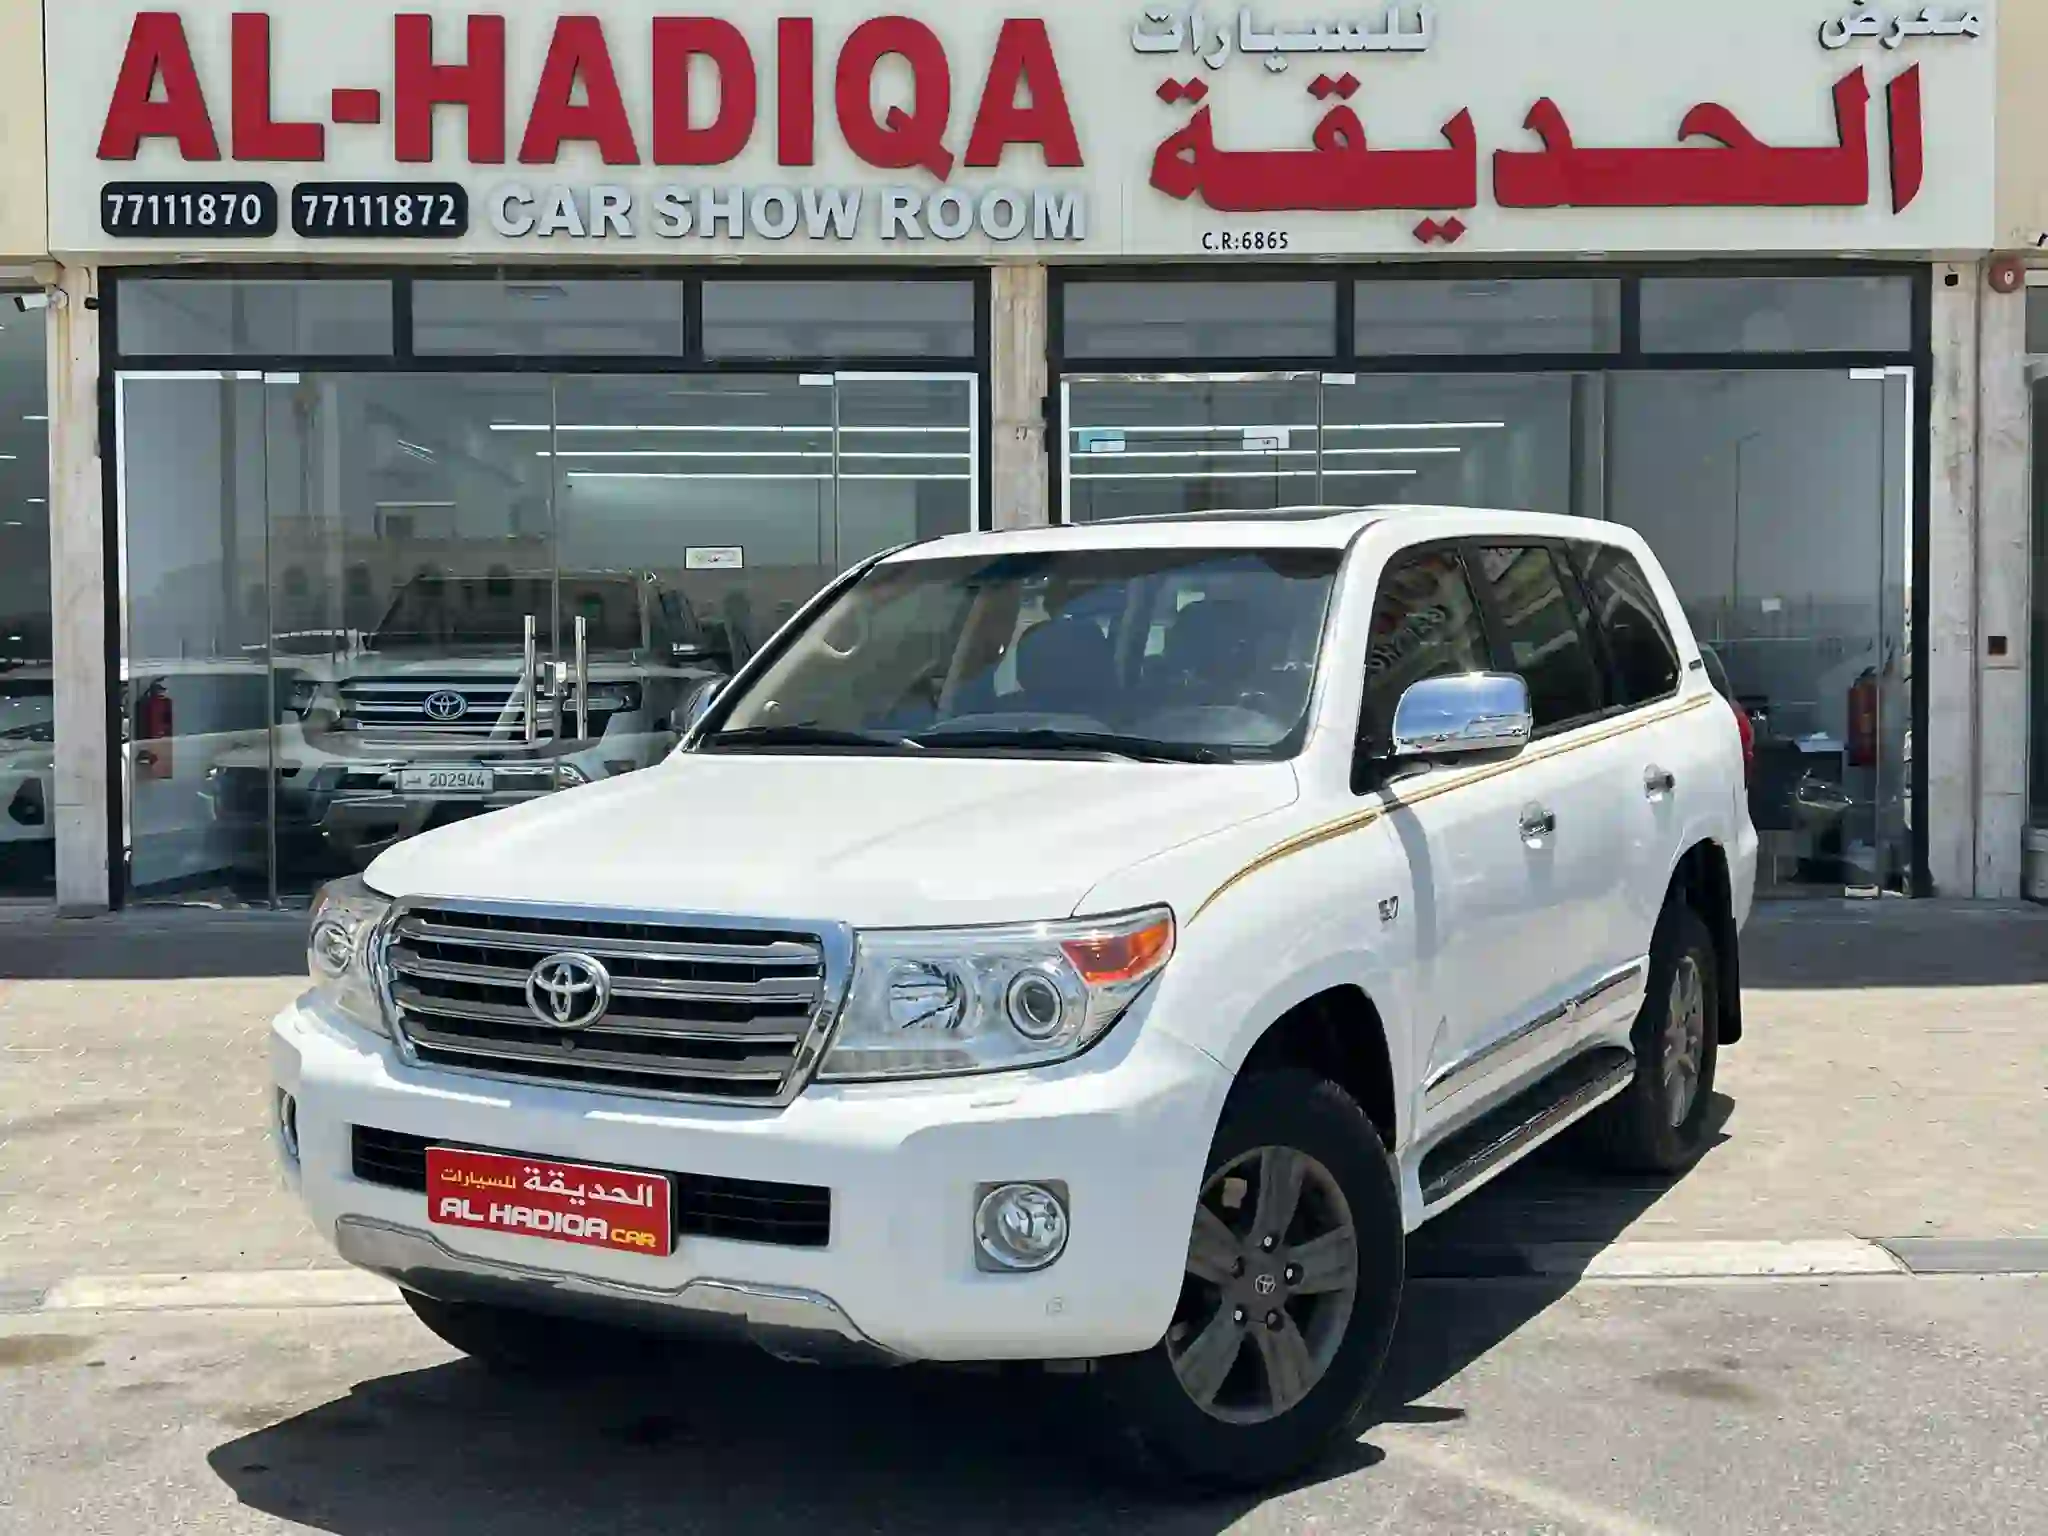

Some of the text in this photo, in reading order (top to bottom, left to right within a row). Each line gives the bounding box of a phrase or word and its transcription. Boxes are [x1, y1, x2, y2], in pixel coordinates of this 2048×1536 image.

[1131, 3, 1435, 73] للسيارات
[1818, 0, 1981, 51] معرض
[97, 11, 1084, 182] AL-HADIQA
[1149, 62, 1924, 244] الحديقة
[106, 193, 262, 227] 77111870
[301, 193, 457, 227] 77111872
[489, 183, 1086, 241] CAR SHOW ROOM
[1202, 231, 1289, 250] C.R:6865
[440, 1165, 653, 1208] الحديقة للسيارات
[439, 1196, 485, 1221] AL
[611, 1227, 657, 1248] CAR
